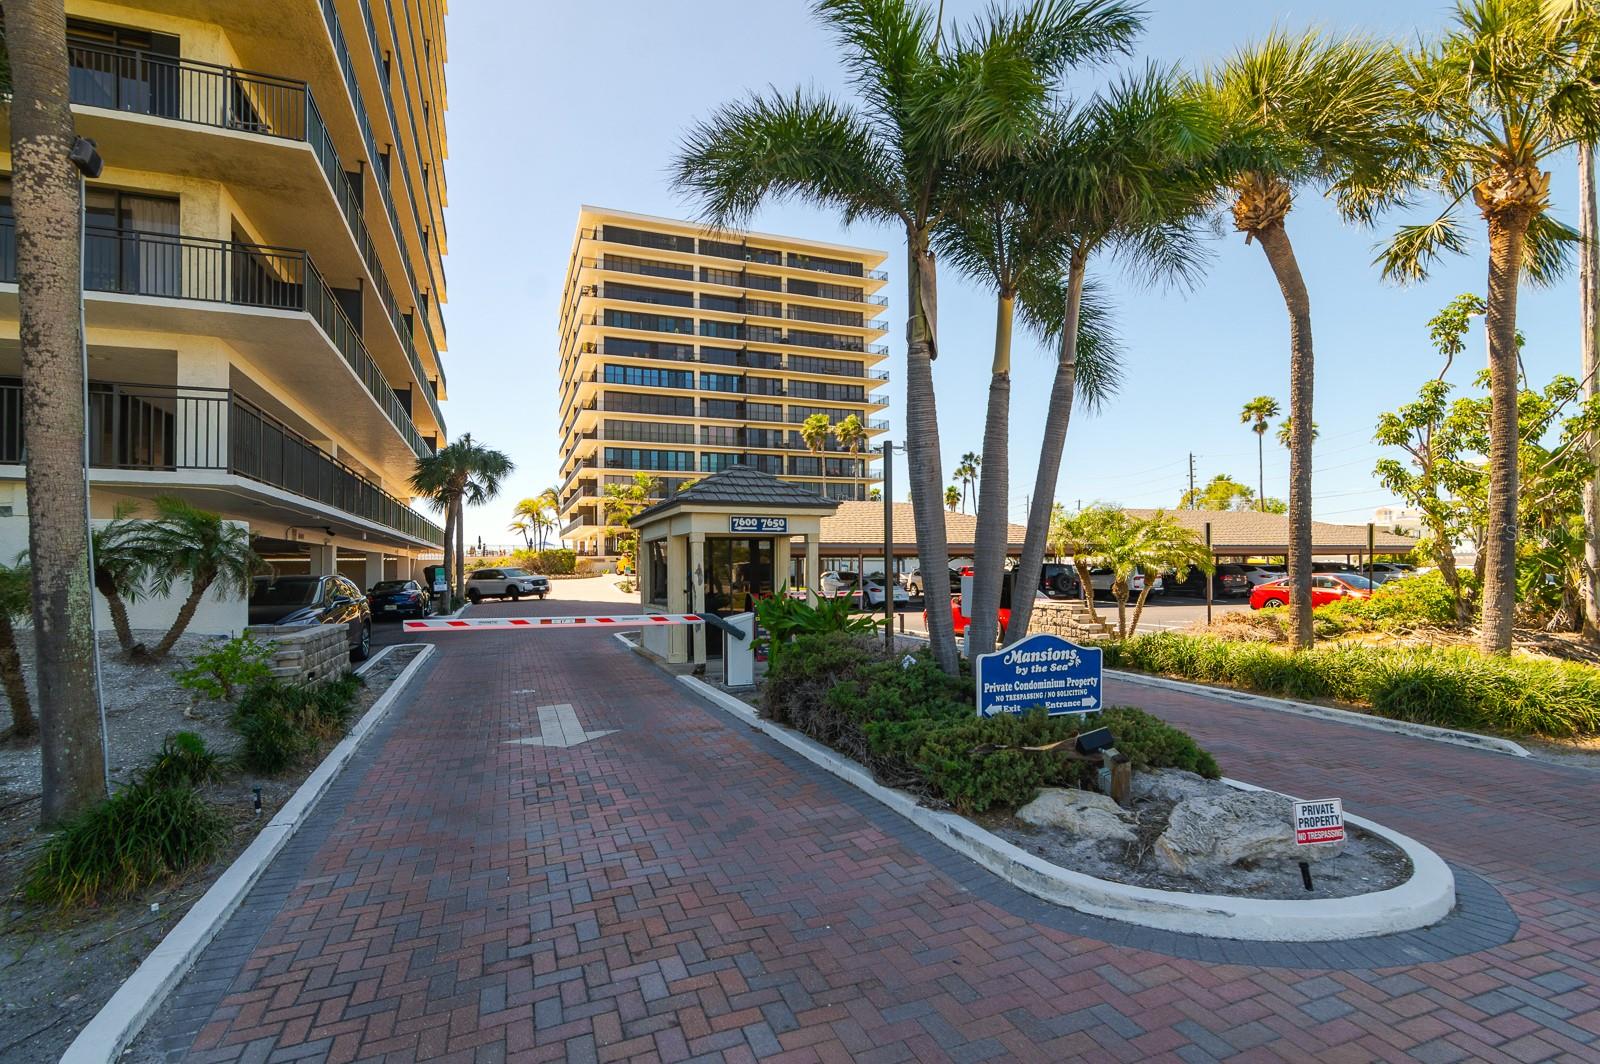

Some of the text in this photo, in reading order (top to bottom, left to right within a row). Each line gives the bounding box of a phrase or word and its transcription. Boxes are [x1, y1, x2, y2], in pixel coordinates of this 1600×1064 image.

[733, 518, 785, 528] 7600 7650
[1003, 648, 1078, 664] Mansions
[1015, 663, 1068, 676] by the Sea
[984, 676, 1098, 694] Private Condominium Property
[995, 694, 1005, 702] NO
[1005, 692, 1043, 701] TRESPASSING
[1047, 690, 1056, 698] NO
[1056, 688, 1088, 698] SOLICITING
[1003, 704, 1021, 713] Exit
[1045, 700, 1081, 709] Entrance
[1302, 803, 1335, 815] PRIVATE
[1298, 815, 1340, 828] PROPERTY
[1298, 829, 1344, 840] NO TRESPASSING
